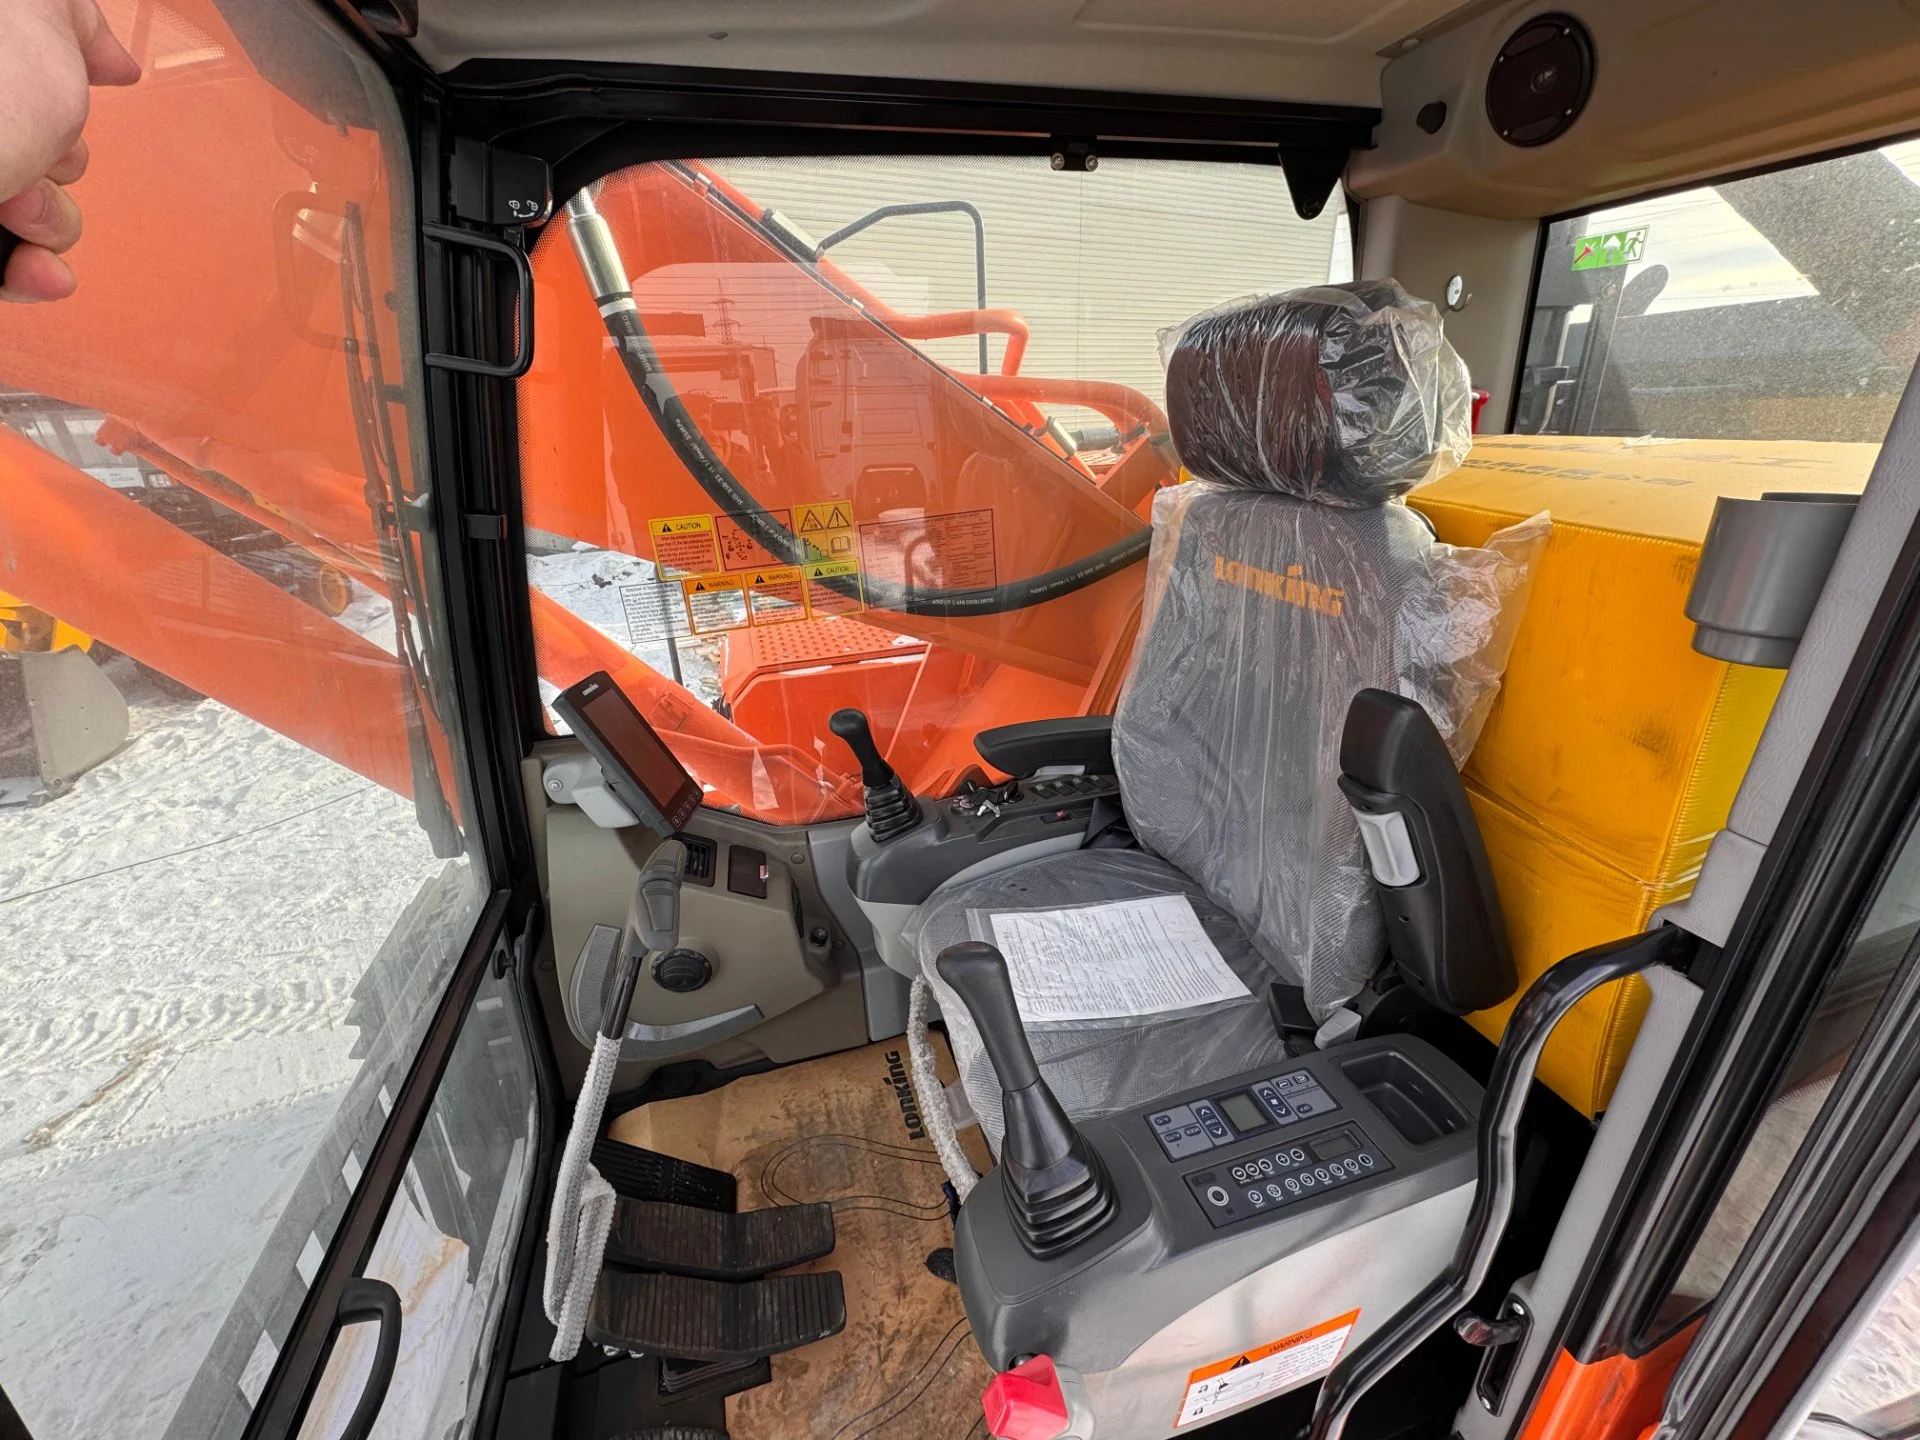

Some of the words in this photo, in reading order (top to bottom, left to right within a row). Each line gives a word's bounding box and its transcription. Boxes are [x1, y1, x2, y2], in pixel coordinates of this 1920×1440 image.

[675, 522, 702, 531] CAUTION
[826, 566, 850, 575] CAUTION
[768, 572, 794, 581] WARNING
[708, 579, 735, 588] WARNING
